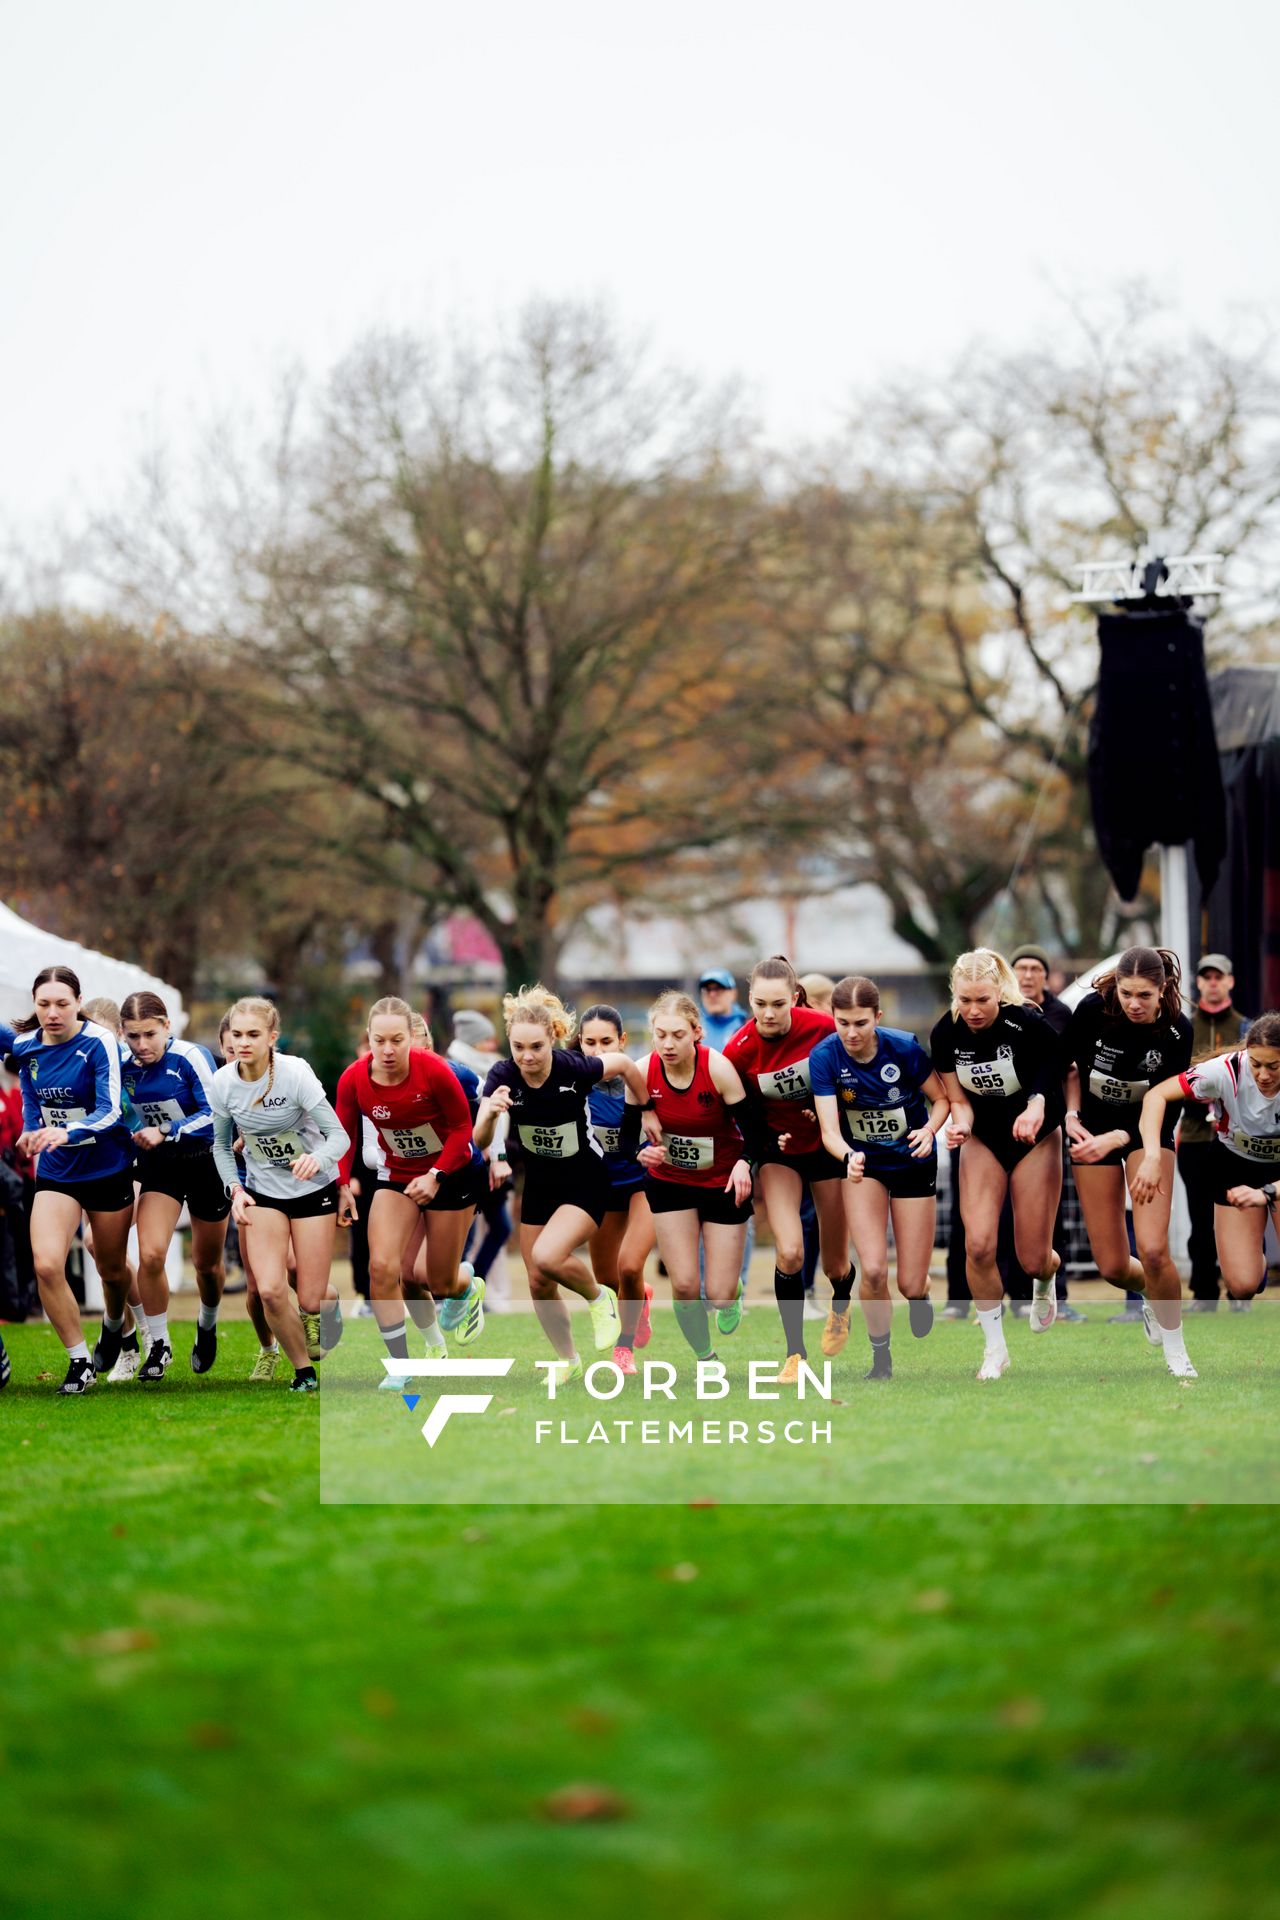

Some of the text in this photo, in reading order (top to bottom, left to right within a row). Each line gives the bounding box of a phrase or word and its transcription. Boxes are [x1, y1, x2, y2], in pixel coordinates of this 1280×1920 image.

[773, 1067, 795, 1080] GLS
[971, 1064, 992, 1074] GLS
[774, 1075, 806, 1094] 171
[971, 1074, 1004, 1088] 955
[1106, 1079, 1128, 1088] GLS
[36, 1087, 74, 1099] HEITEC
[1101, 1085, 1131, 1098] 951
[50, 1110, 67, 1119] GLS
[142, 1104, 161, 1113] GLS
[862, 1111, 884, 1119] GLS
[856, 1119, 899, 1133] 1126
[257, 1137, 278, 1145] GLS
[394, 1136, 426, 1149] 378
[532, 1135, 564, 1148] 987
[671, 1137, 693, 1145] GLS
[1250, 1137, 1273, 1145] GLS
[669, 1145, 700, 1160] 653
